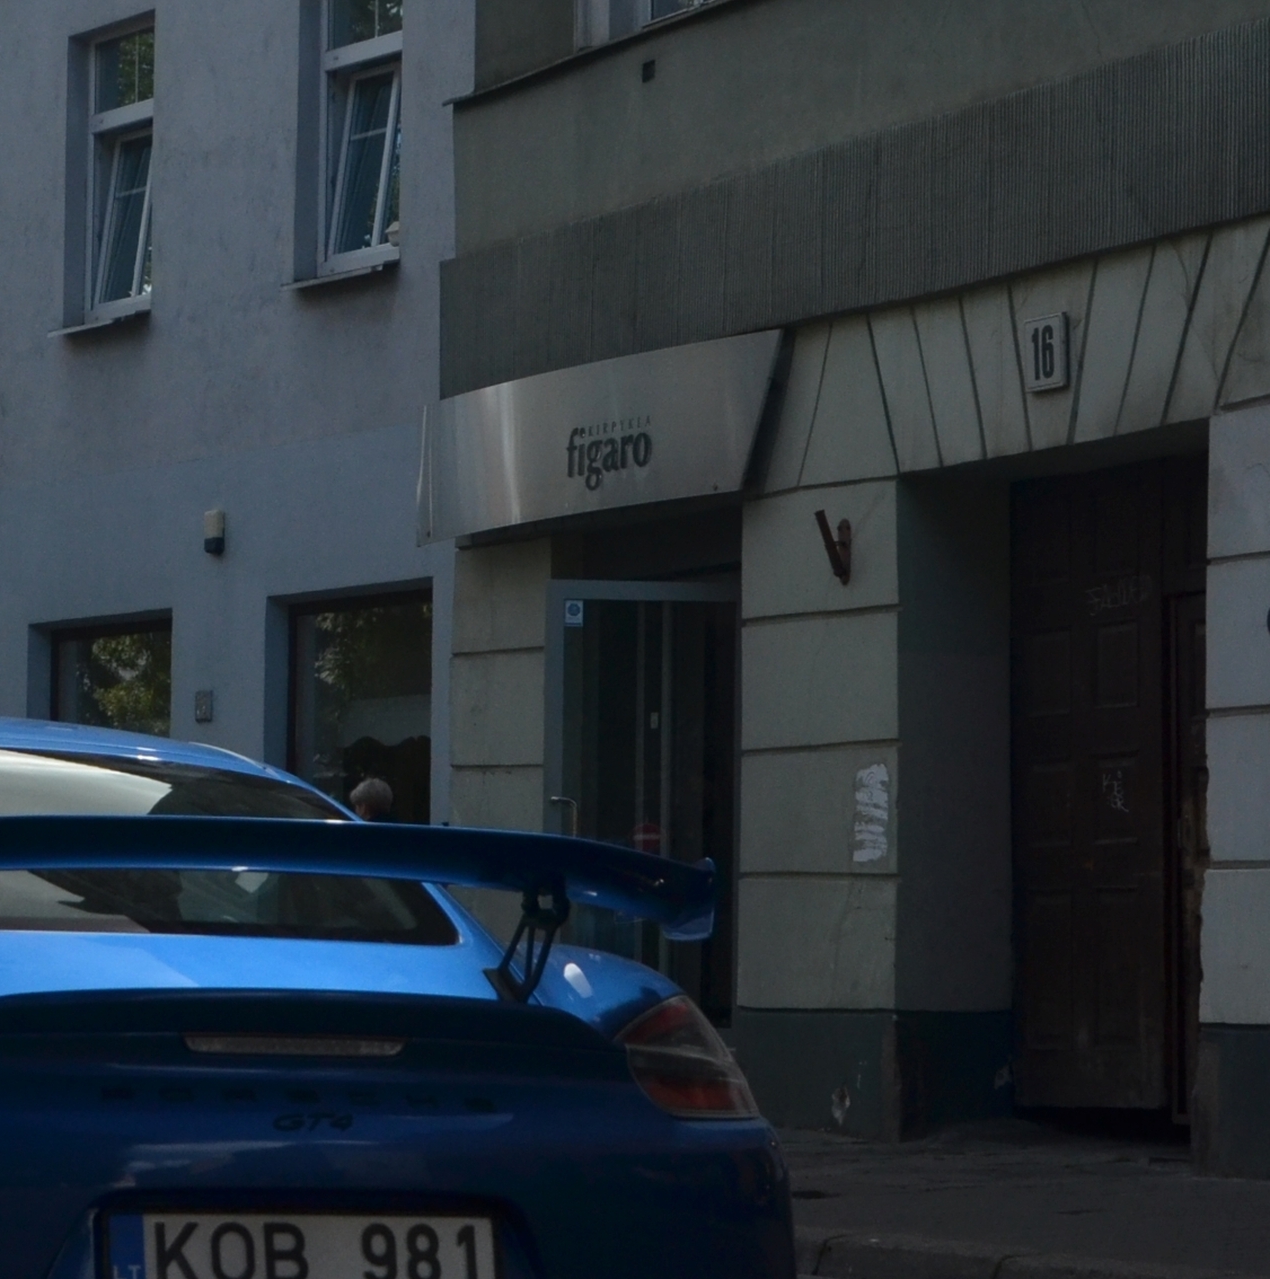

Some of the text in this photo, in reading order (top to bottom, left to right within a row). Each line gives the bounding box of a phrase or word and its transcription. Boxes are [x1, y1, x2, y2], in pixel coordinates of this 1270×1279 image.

[1031, 324, 1055, 381] 16
[566, 426, 653, 491] figaro
[271, 1111, 355, 1132] GT4
